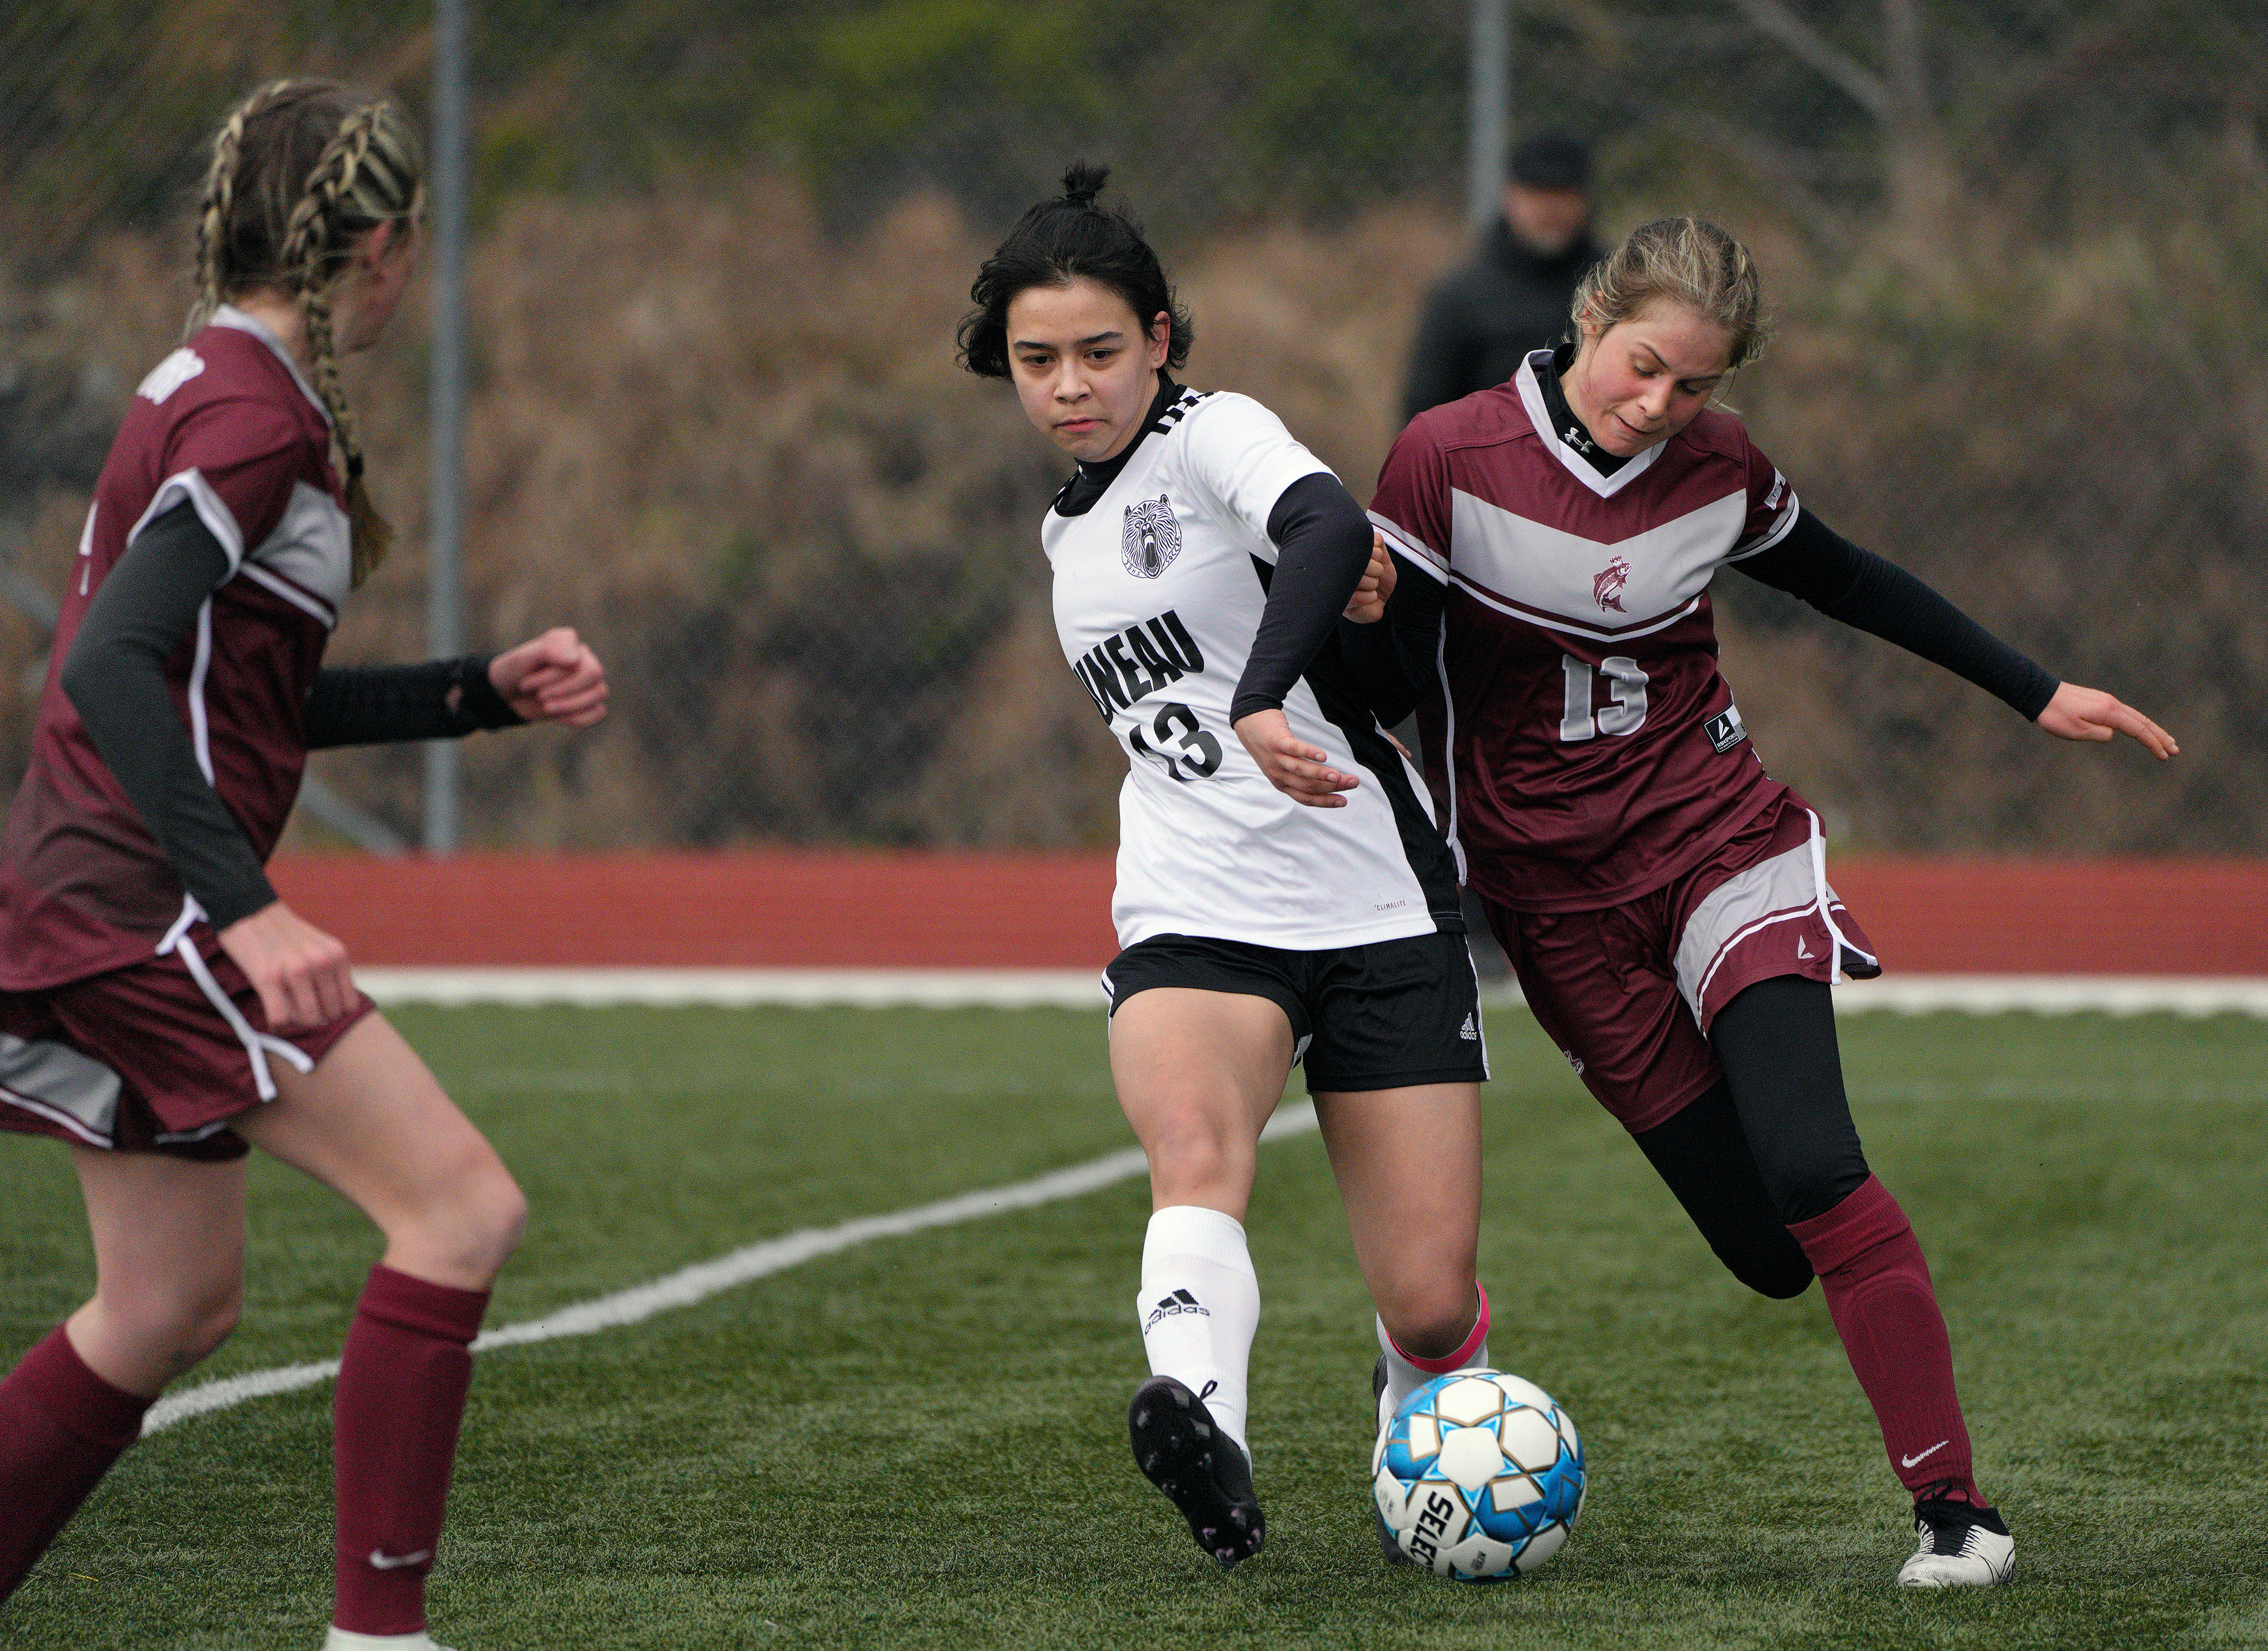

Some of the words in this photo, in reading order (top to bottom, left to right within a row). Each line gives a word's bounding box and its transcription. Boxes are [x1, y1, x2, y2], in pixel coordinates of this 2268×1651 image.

[1073, 609, 1205, 727] UNEAU
[1560, 654, 1649, 741] 13
[1129, 703, 1223, 783] 13
[1460, 1030, 1477, 1040] adidas
[1145, 1304, 1210, 1336] adidas
[1409, 1491, 1453, 1568] SELEC
